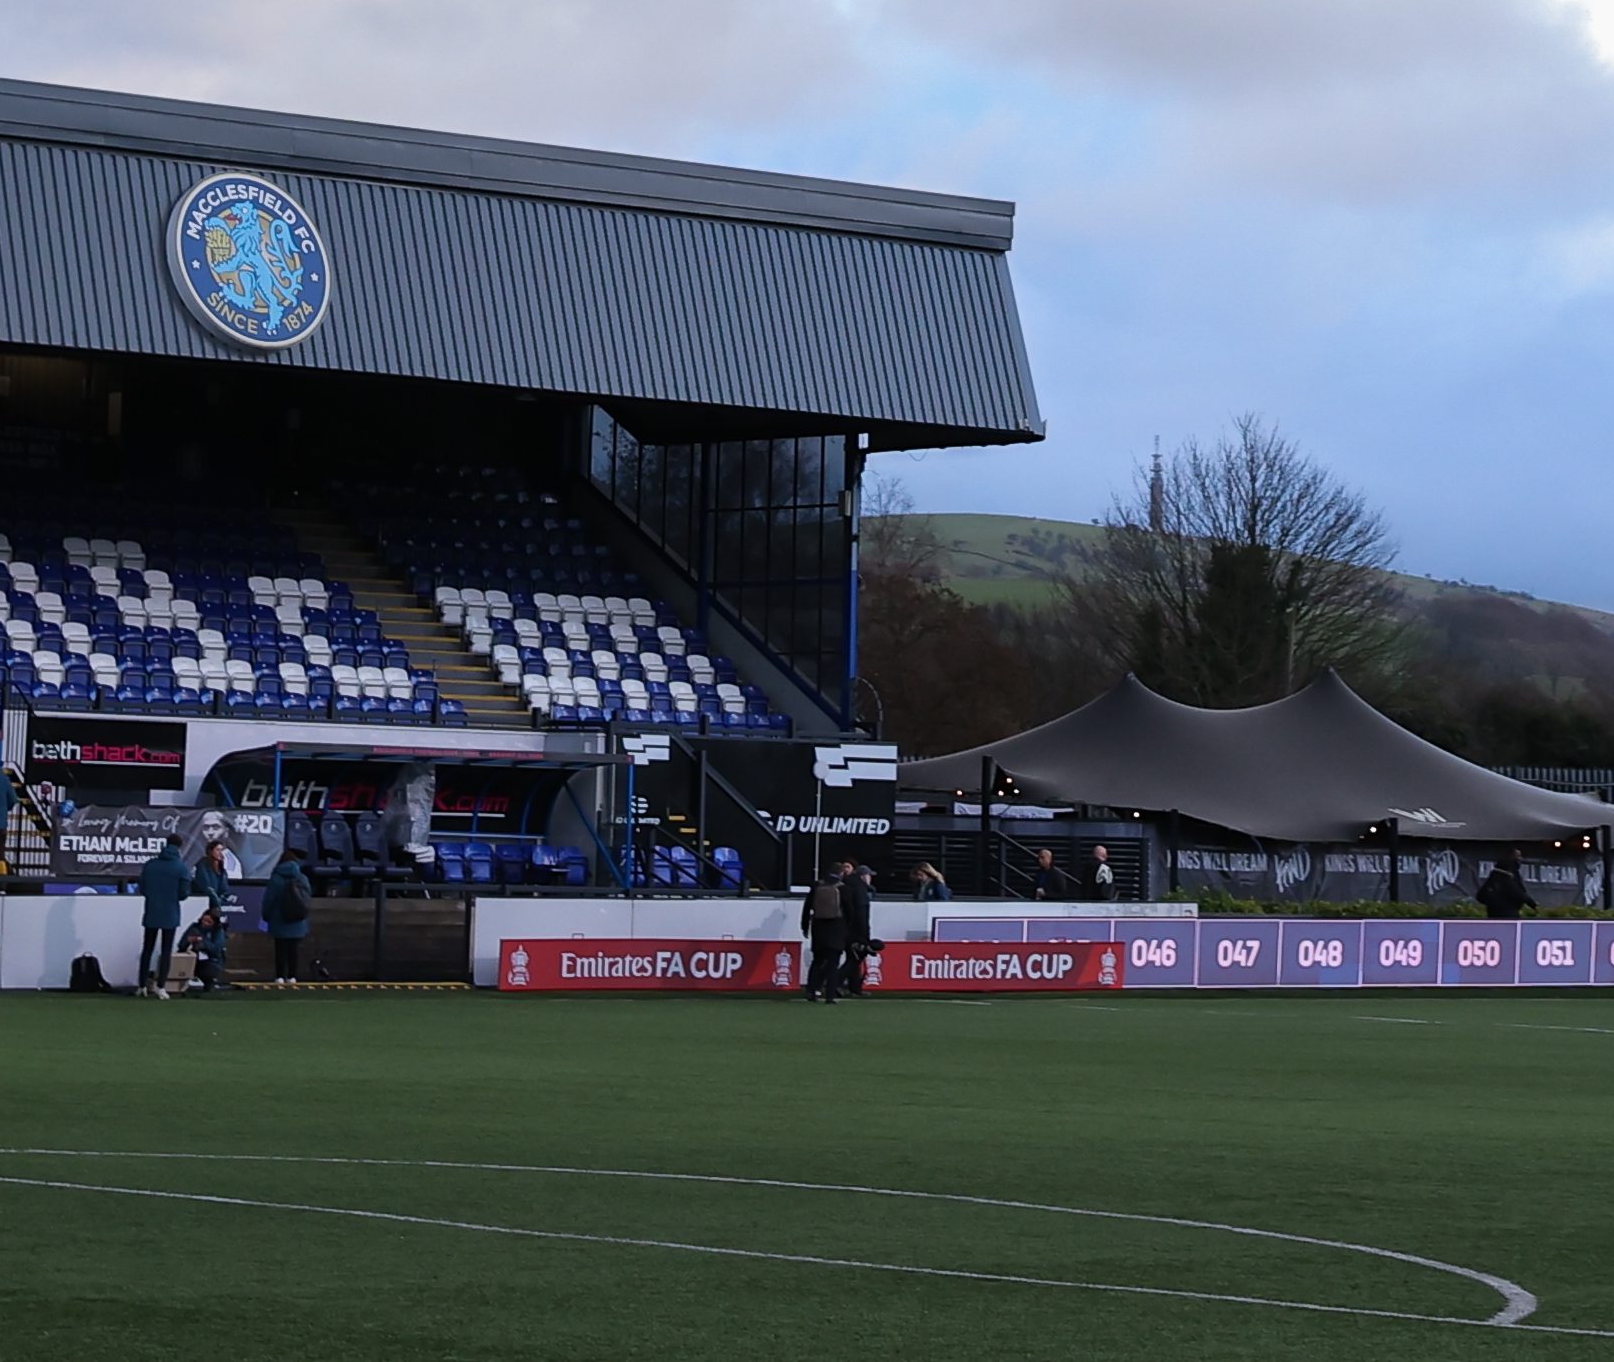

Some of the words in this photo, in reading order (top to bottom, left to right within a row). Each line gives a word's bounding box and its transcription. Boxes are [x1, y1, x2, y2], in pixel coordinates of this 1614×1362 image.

[186, 184, 296, 239] MACCLESFIELD
[295, 226, 315, 253] FC
[207, 293, 259, 335] SINCE
[283, 300, 314, 332] 1874
[32, 739, 180, 763] bathshack.com
[235, 815, 273, 834] #20
[776, 816, 796, 832] ID
[799, 816, 890, 835] UNLIMITED
[60, 836, 112, 852] ETHAN
[560, 950, 653, 978] Emirates
[655, 950, 686, 978] FA
[689, 951, 743, 979] CUP
[910, 952, 994, 980] Emirates
[995, 952, 1023, 980] FA
[1026, 953, 1073, 980] CUP
[1131, 939, 1177, 967] 046
[1217, 939, 1260, 967] 047
[1298, 940, 1343, 967] 048
[1379, 939, 1422, 967] 049
[1457, 940, 1500, 967] 050
[1536, 940, 1575, 966] 051
